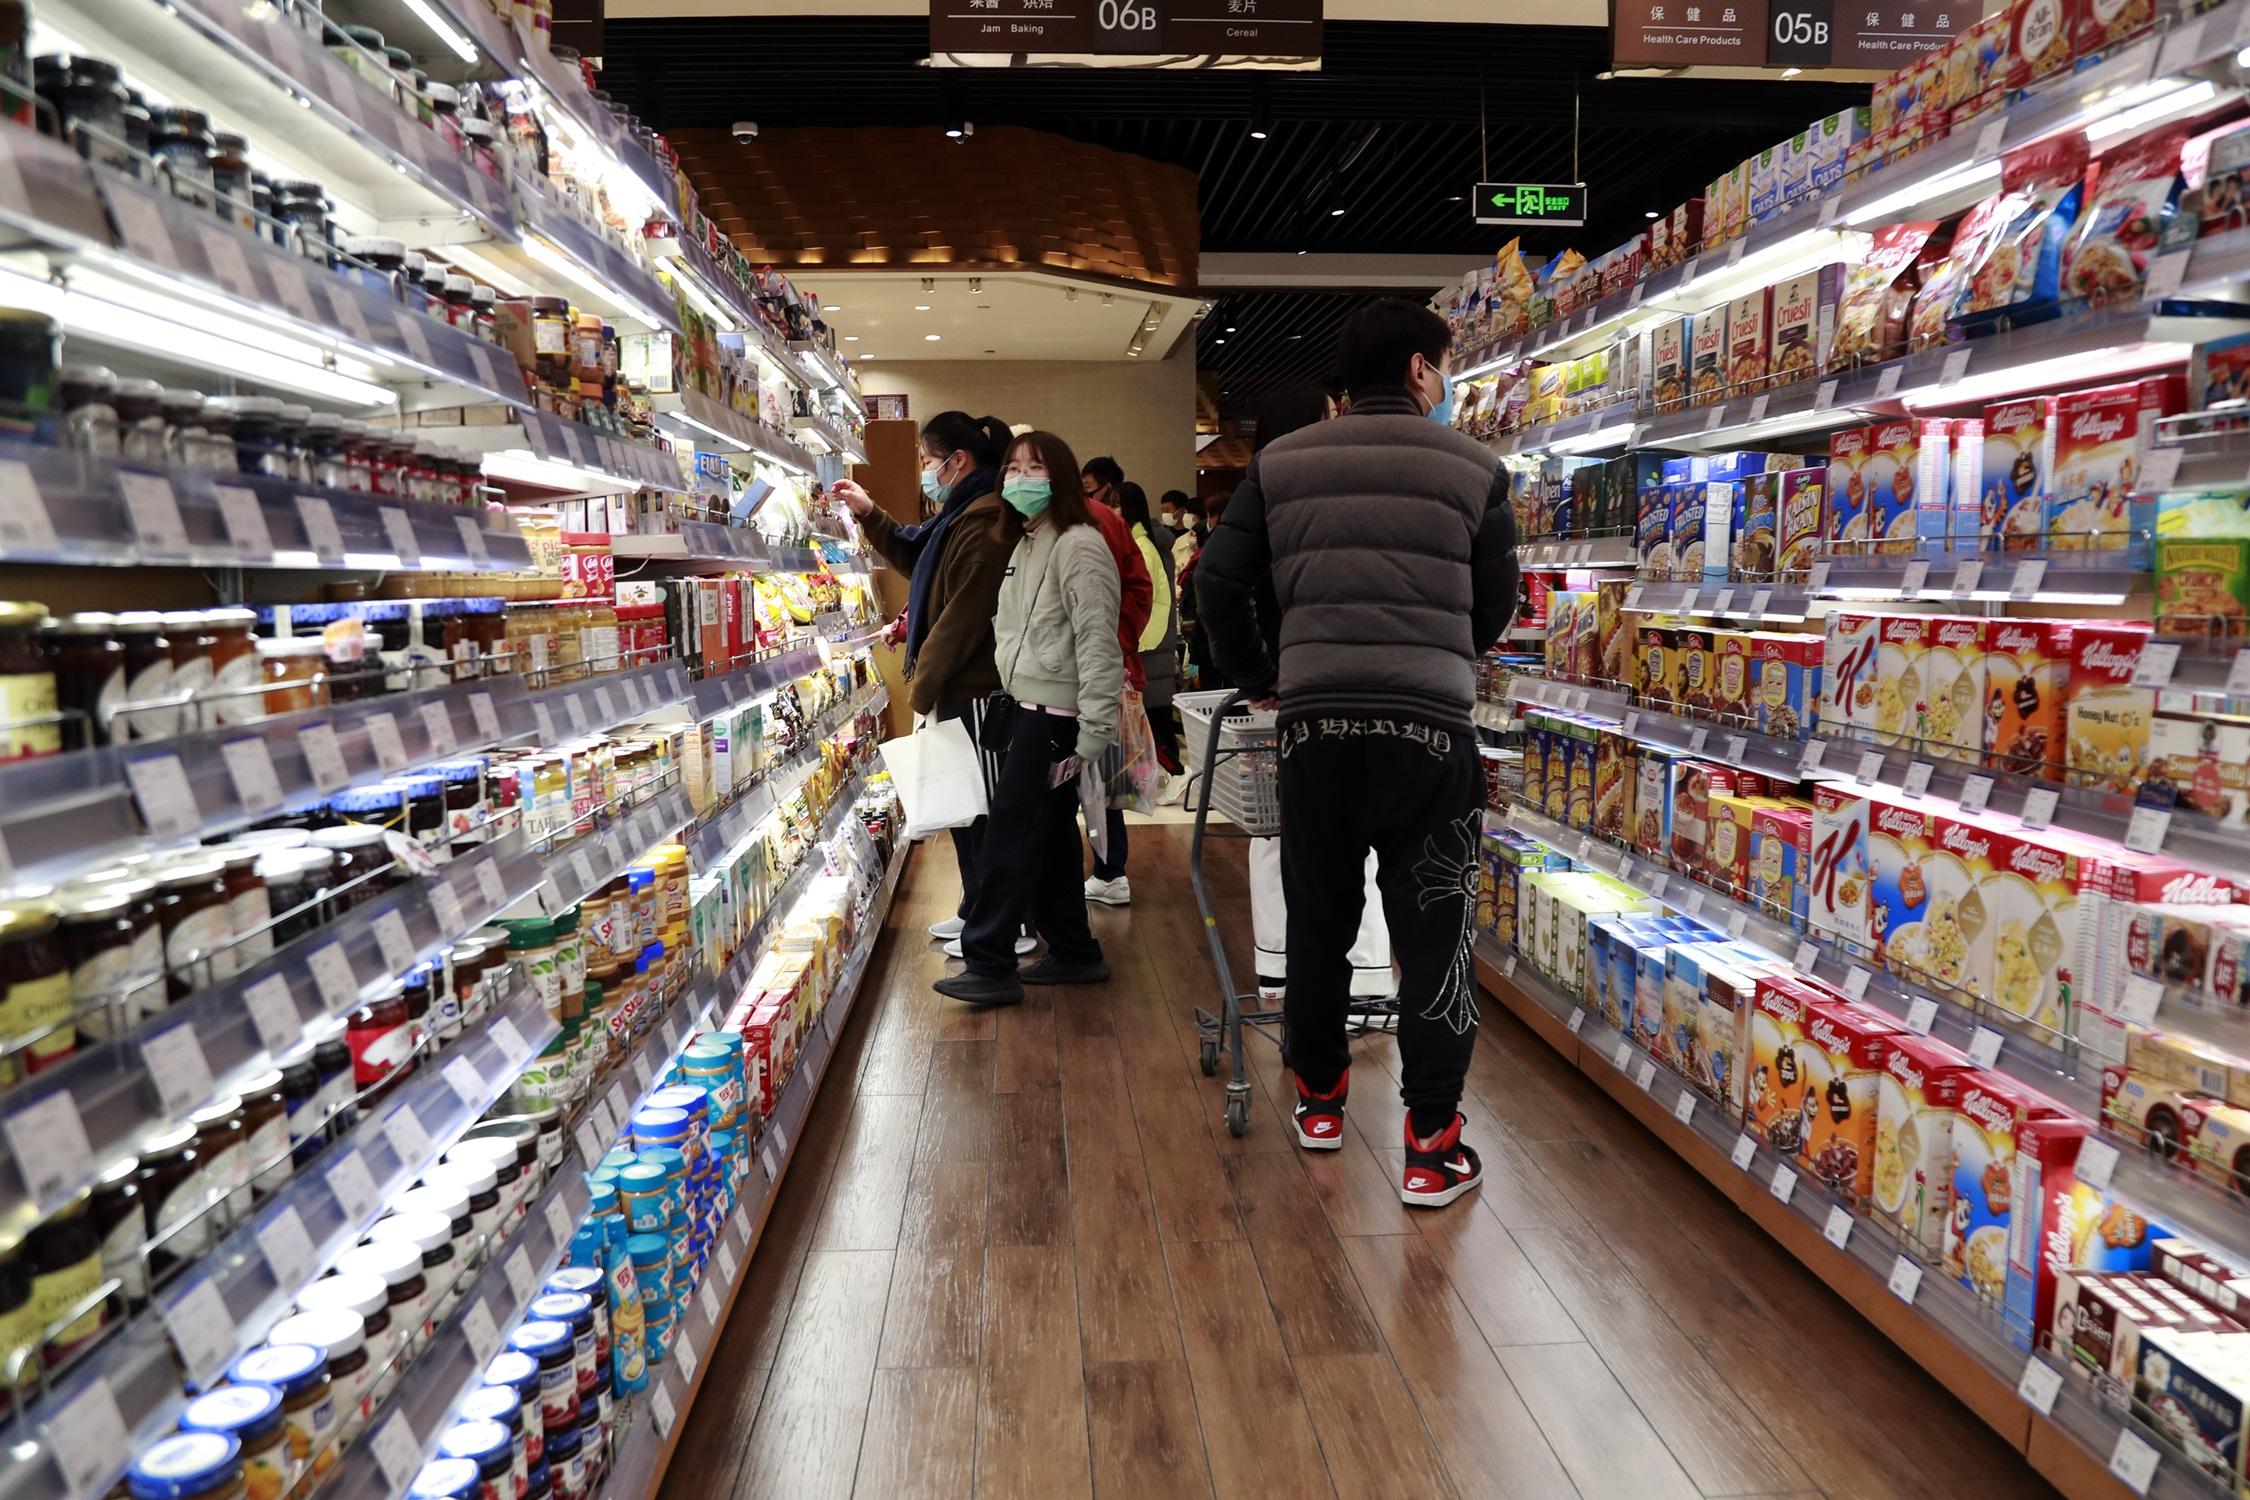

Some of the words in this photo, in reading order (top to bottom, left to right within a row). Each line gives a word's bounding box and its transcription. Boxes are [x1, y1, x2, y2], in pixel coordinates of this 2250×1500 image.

[980, 23, 1001, 34] Jam
[1010, 24, 1045, 36] Baking
[1097, 0, 1158, 30] 06B
[1649, 5, 1737, 23] 保健品
[1774, 12, 1829, 45] 05B
[1865, 12, 1950, 28] 保健品
[1226, 27, 1259, 38] Cereal
[1643, 34, 1675, 45] Health
[1675, 35, 1698, 45] Care
[1699, 35, 1742, 47] Products
[1858, 39, 1889, 50] Health
[1889, 40, 1912, 51] Care
[1776, 297, 1812, 329] Cruesli
[2070, 411, 2126, 442] Kellogg's
[1540, 473, 1561, 506] Alpen
[1785, 490, 1821, 525] RAISIN
[1785, 511, 1815, 543] BRAN
[1834, 634, 1876, 718] K
[2077, 706, 2103, 724] Honey
[2103, 708, 2119, 724] Nut
[1878, 806, 1926, 838] Kellogg's
[1942, 822, 1991, 858] Kellogg's
[1813, 818, 1861, 914] K
[2011, 842, 2066, 883] Kellogg's
[1760, 990, 1800, 1023] Kellogg's
[1810, 1018, 1851, 1054] Kellogg's
[1887, 1049, 1926, 1090] Kellogg's
[1961, 1088, 2014, 1135] Kellogg's
